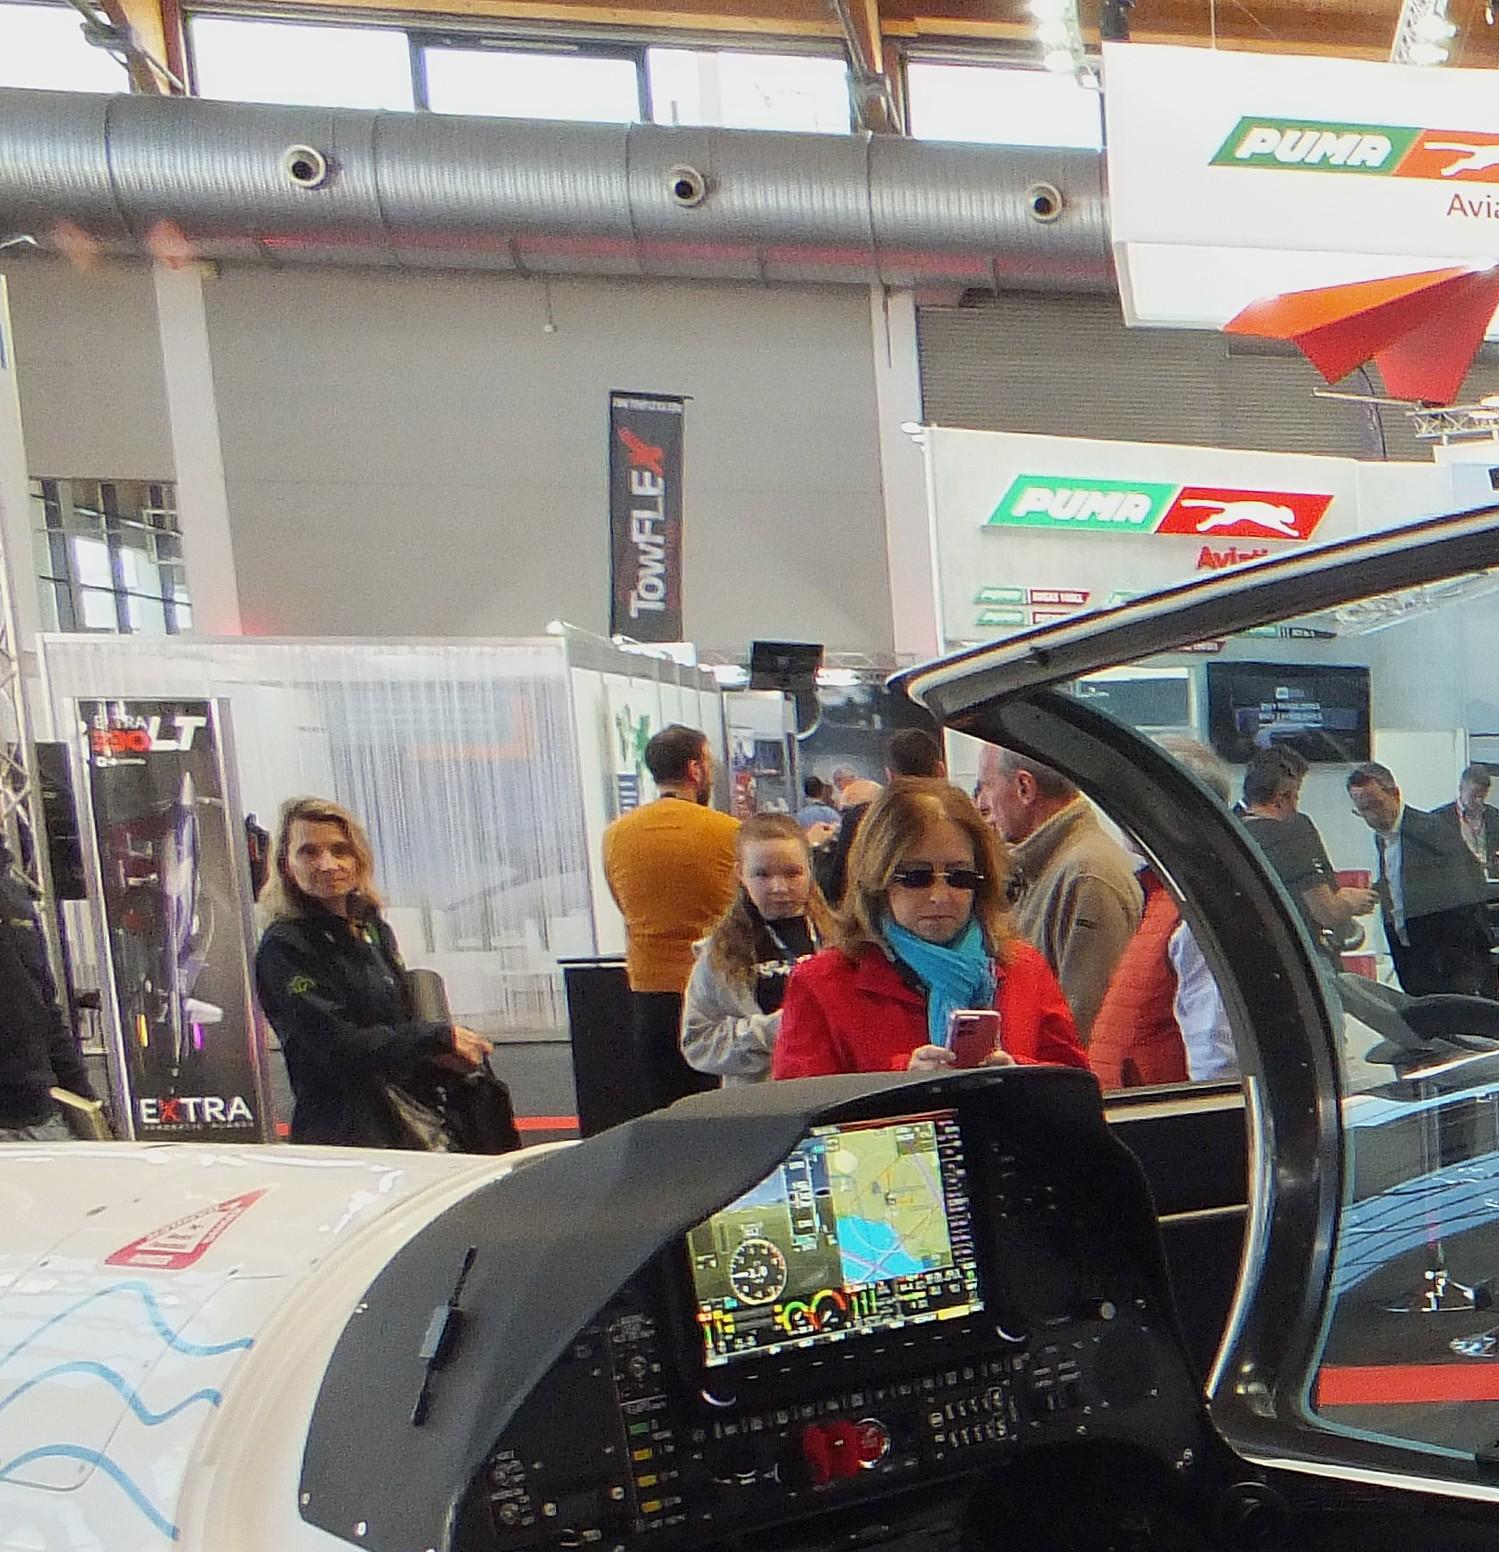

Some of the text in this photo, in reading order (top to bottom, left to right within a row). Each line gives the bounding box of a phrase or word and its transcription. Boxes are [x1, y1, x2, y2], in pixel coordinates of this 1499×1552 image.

[1234, 126, 1393, 168] PUMA
[1010, 487, 1152, 524] PUMA
[140, 1096, 254, 1123] EXTRA
